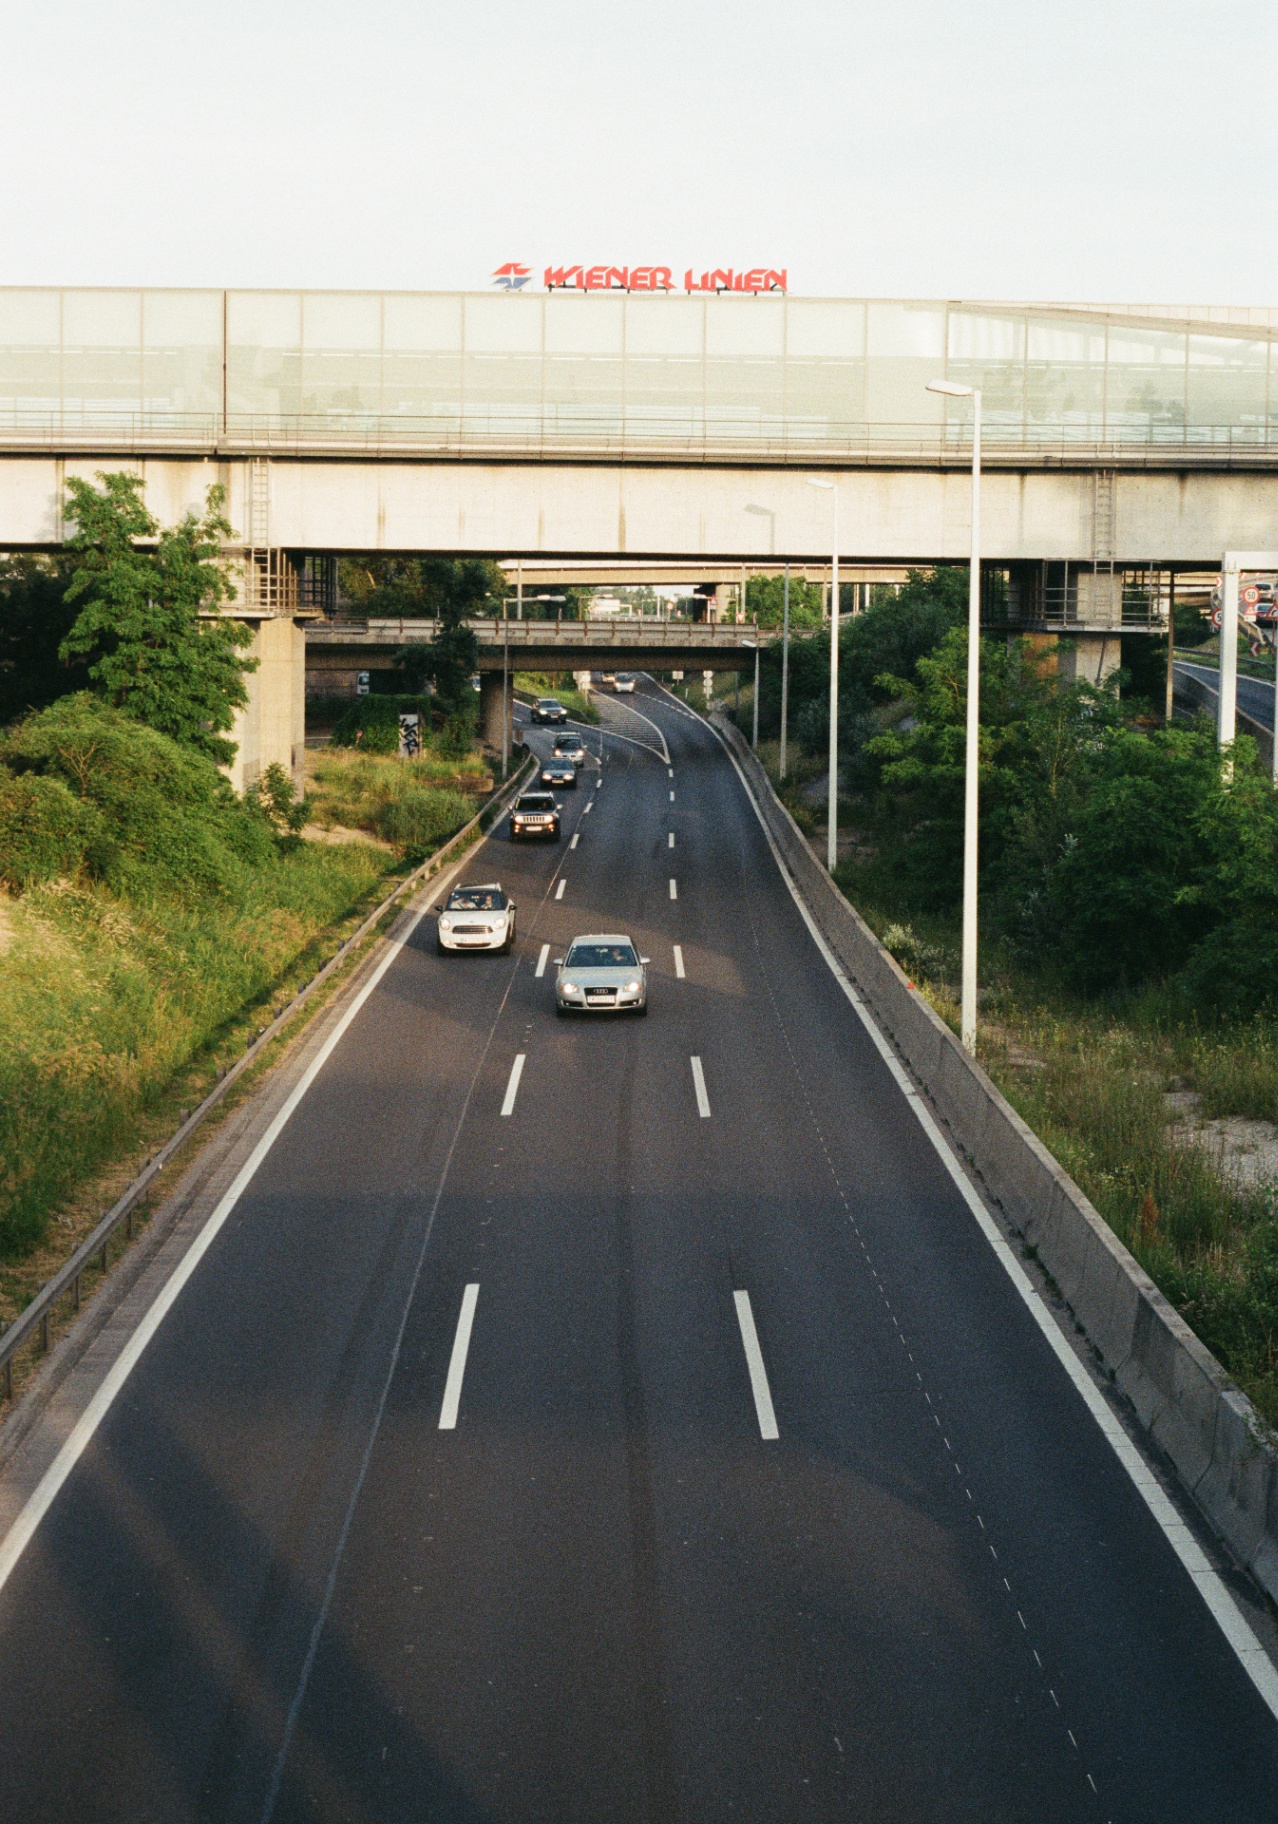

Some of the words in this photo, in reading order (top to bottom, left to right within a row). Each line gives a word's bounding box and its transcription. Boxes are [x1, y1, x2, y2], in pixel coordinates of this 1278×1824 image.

[544, 265, 677, 290] WIENER
[684, 268, 787, 292] LINIEN
[1247, 591, 1256, 600] 50
